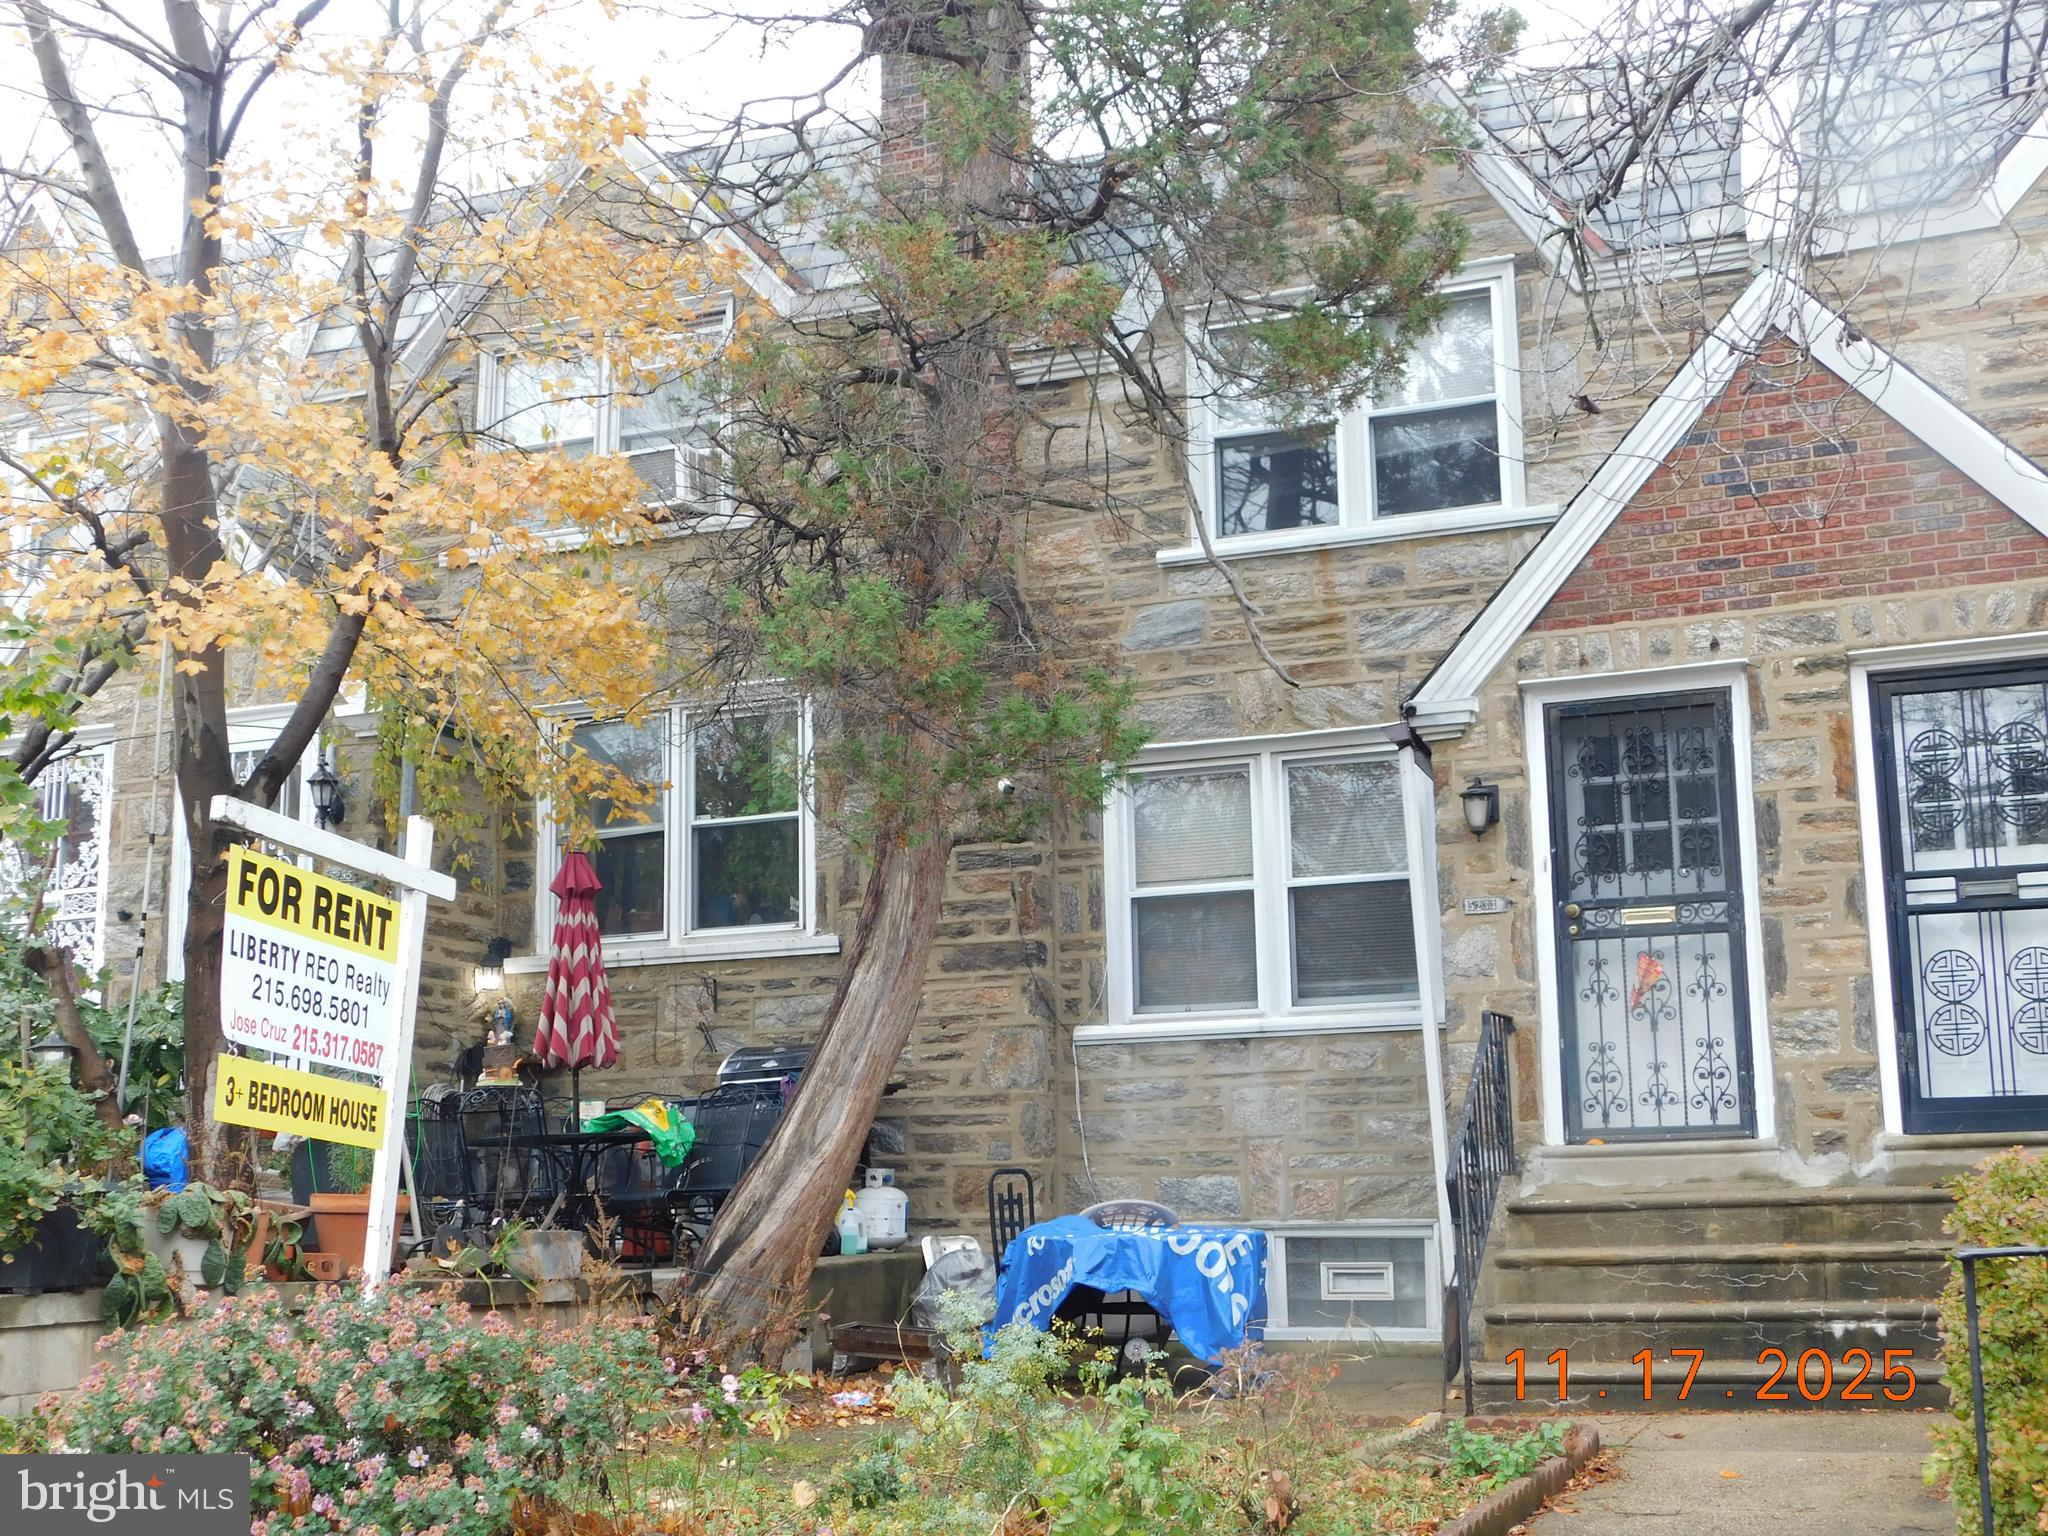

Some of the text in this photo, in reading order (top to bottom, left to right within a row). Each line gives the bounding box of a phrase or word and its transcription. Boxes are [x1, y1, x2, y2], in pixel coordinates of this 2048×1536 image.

[238, 859, 392, 951] FOR RENT
[230, 929, 391, 1006] LIBERTY REO Realty
[252, 973, 369, 1028] 215.698.5801
[230, 1009, 384, 1069] Jose Cruz 215.317.0587
[225, 1076, 377, 1132] 3+ BEDROOM HOUSE
